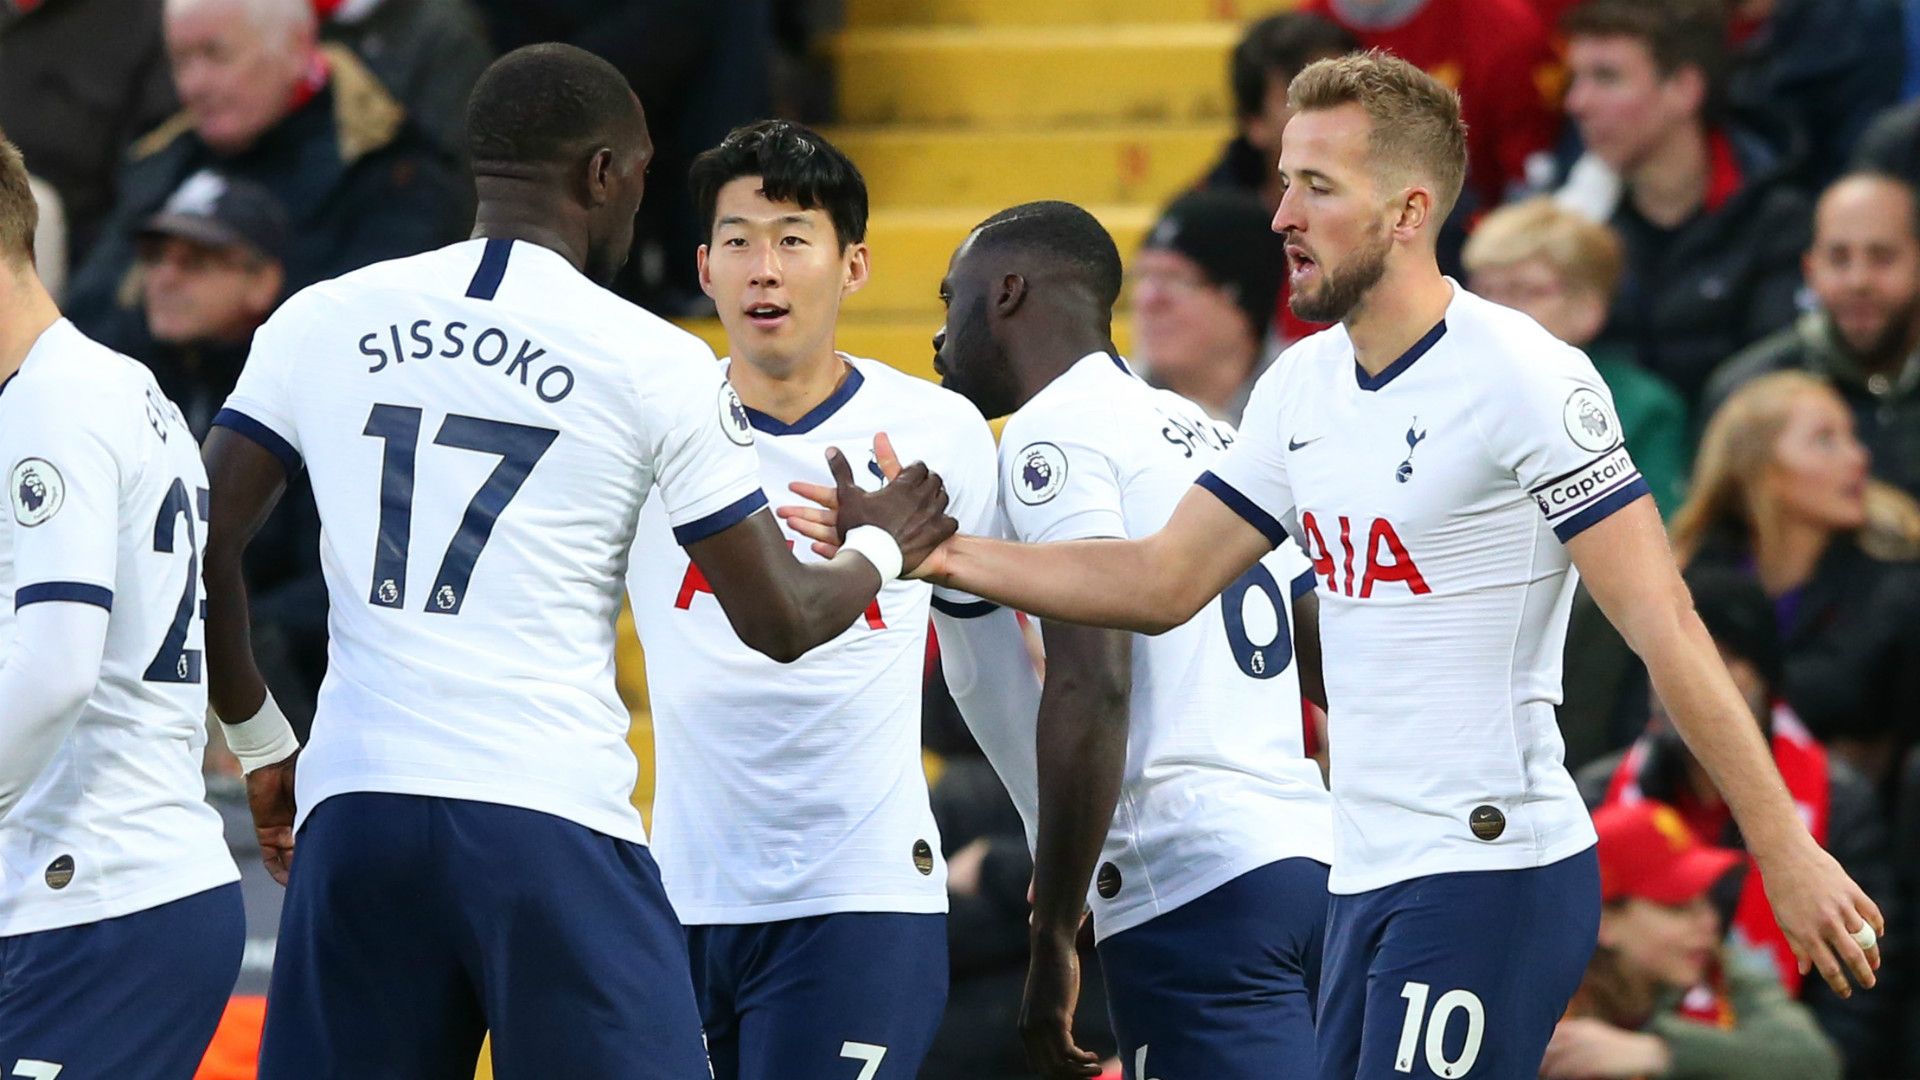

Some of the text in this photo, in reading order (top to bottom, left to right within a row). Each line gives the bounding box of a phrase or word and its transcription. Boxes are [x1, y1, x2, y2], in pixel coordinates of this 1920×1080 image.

[358, 319, 575, 403] SISSOKO
[362, 402, 560, 615] 17
[1551, 456, 1630, 505] Captain
[142, 476, 210, 684] 2
[1302, 511, 1432, 598] AIA
[1394, 981, 1485, 1080] 10
